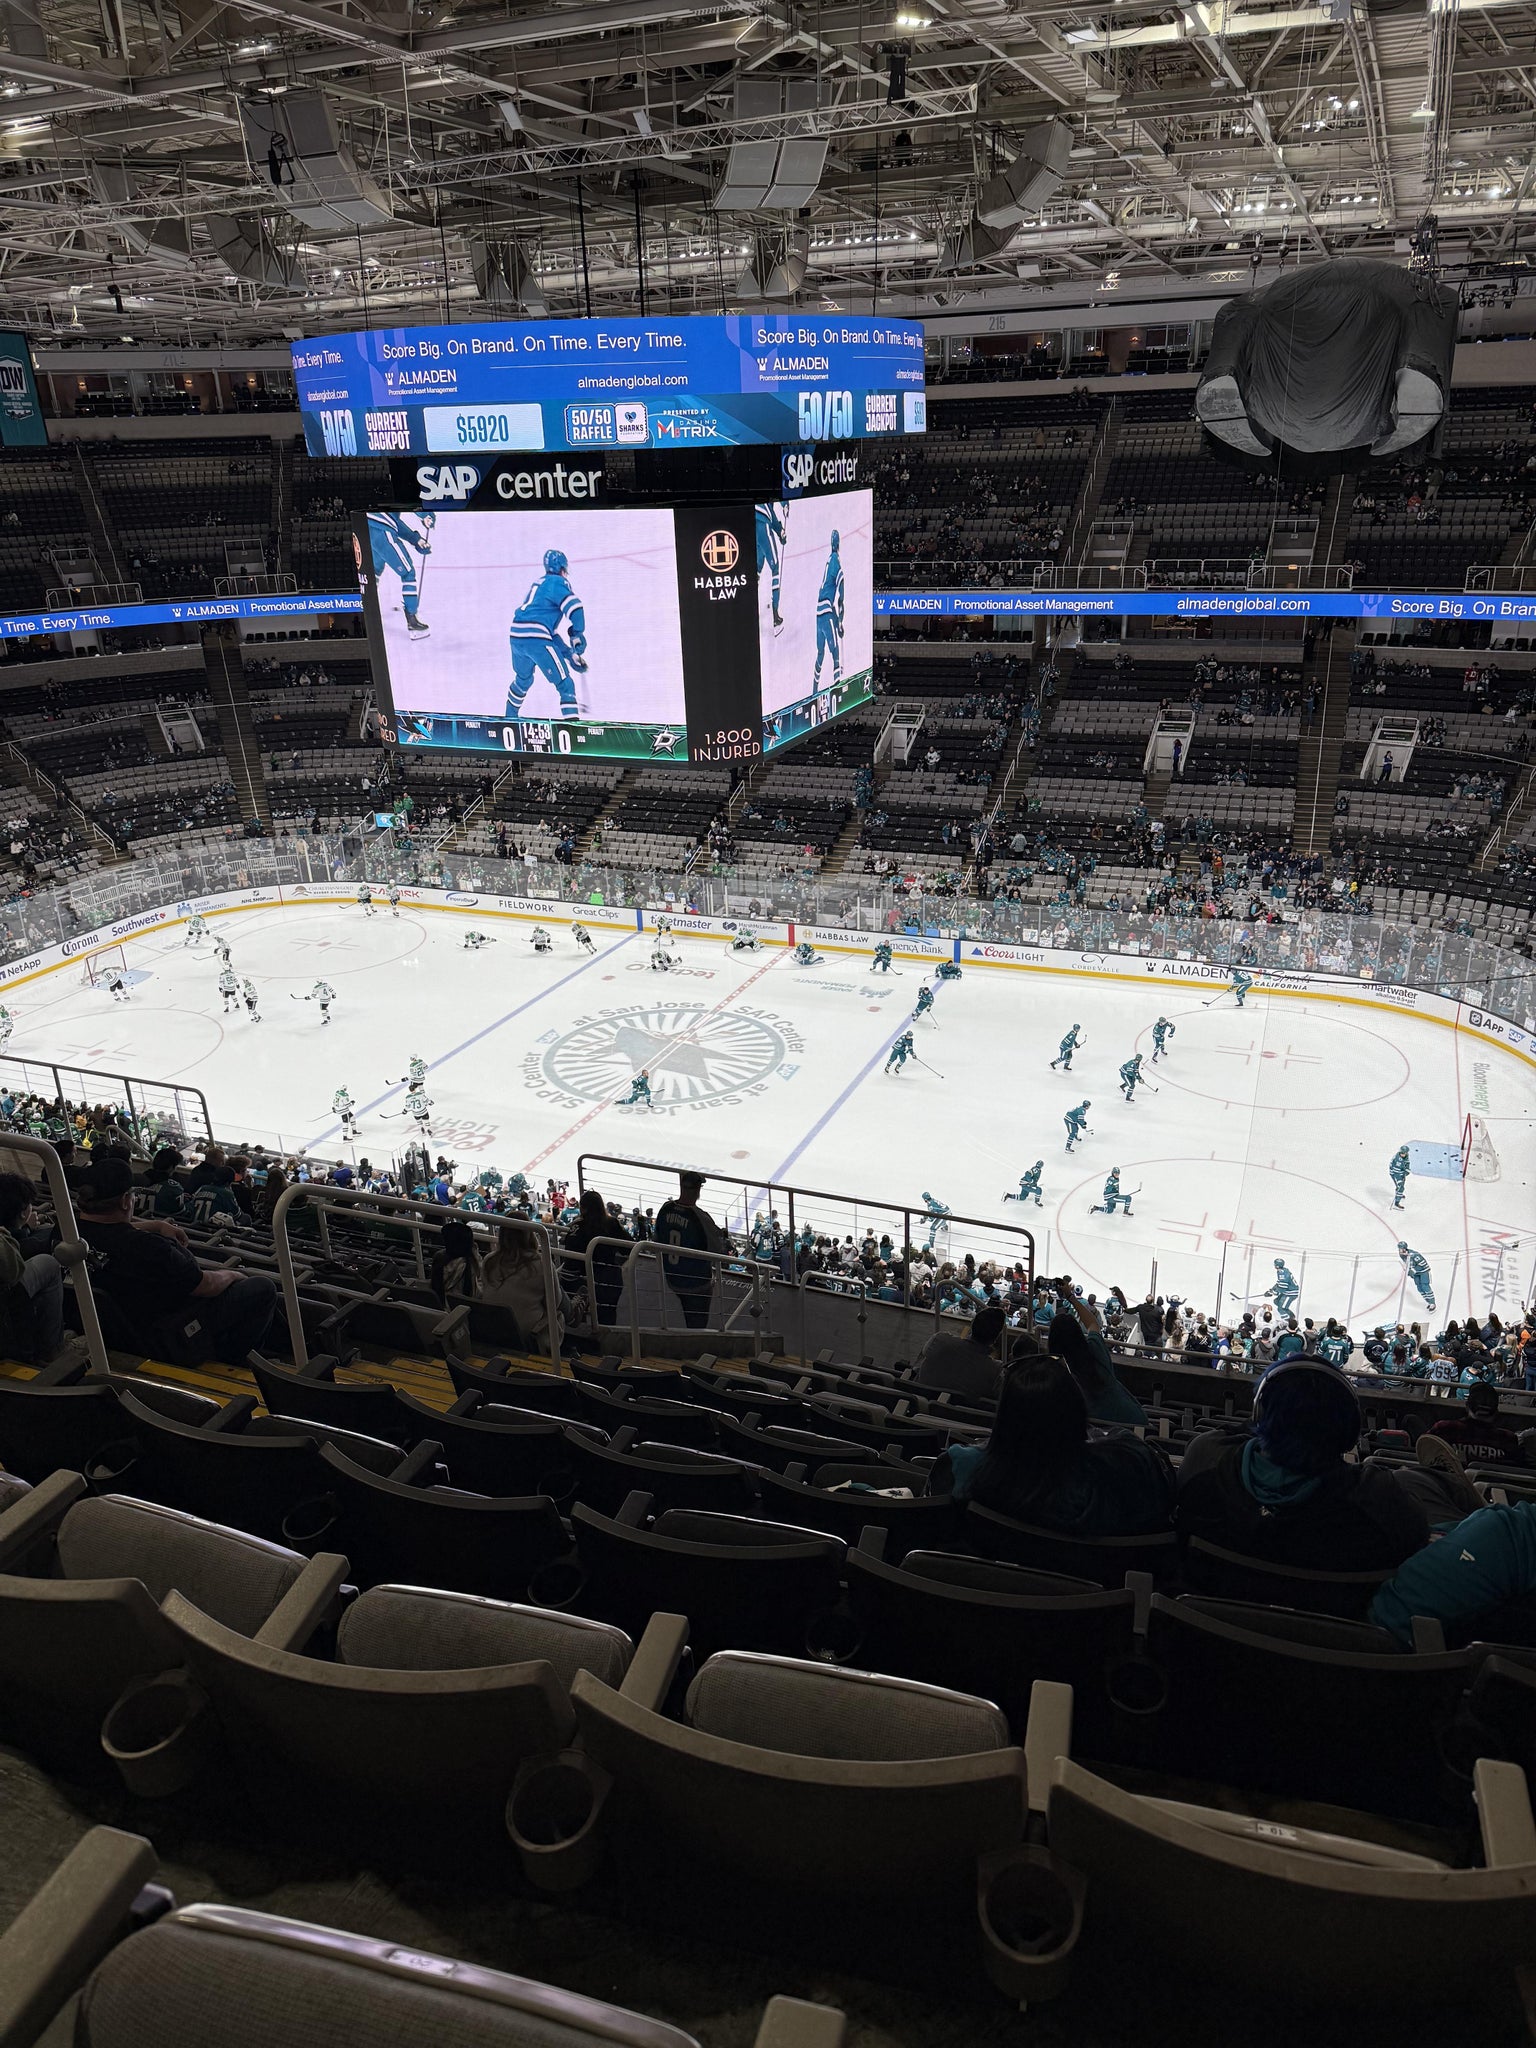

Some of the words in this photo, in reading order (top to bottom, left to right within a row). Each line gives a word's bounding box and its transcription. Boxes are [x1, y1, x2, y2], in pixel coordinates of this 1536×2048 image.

[988, 316, 1005, 331] 215
[383, 343, 416, 359] Score
[419, 341, 444, 359] Big.
[447, 339, 468, 356] On
[471, 337, 519, 355] Brand.
[523, 336, 546, 352] On
[549, 334, 592, 351] Time.
[597, 332, 641, 353] Every
[645, 331, 688, 348] Time.
[757, 328, 795, 345] Score
[798, 329, 820, 347] Big.
[823, 329, 839, 344] On
[841, 328, 871, 344] Brand.
[873, 329, 885, 345] On
[886, 330, 903, 346] Time.
[306, 352, 322, 368] Every
[322, 350, 344, 365] Time.
[773, 356, 829, 371] ALMADEN
[398, 368, 458, 386] ALMADEN
[578, 373, 688, 391] almadenglobal.com
[759, 374, 788, 382] Promotional
[787, 373, 800, 381] Asset
[800, 373, 829, 382] Management
[413, 386, 426, 395] Asset
[426, 386, 458, 396] Management
[866, 394, 897, 413] CURRENT
[364, 411, 408, 432] CURRENT
[572, 408, 611, 426] 50/50
[798, 391, 853, 441] 50/50
[866, 412, 897, 432] JACKPOT
[320, 409, 358, 457] 50/50
[456, 413, 510, 446] $5920
[573, 425, 613, 440] RAFFLE
[618, 424, 645, 433] SHARKS
[367, 430, 411, 451] JACKPOT
[785, 453, 815, 489] SAP
[820, 450, 858, 485] center
[416, 464, 479, 500] SAP
[496, 462, 602, 499] center
[694, 574, 747, 589] HABBAS
[709, 588, 737, 600] LAW
[186, 603, 240, 618] ALMADEN
[250, 600, 307, 614] Promotional
[307, 599, 334, 611] Asset
[889, 599, 942, 611] ALMADEN
[953, 598, 1014, 611] Promotional
[1015, 598, 1045, 611] Asset
[1045, 599, 1114, 613] Management
[1176, 596, 1311, 612] almadenglobal.com
[1391, 598, 1434, 615] Score
[1438, 600, 1467, 617] Big.
[1472, 600, 1495, 616] On
[4, 619, 40, 635] Time.
[42, 616, 78, 633] Every
[79, 613, 115, 627] Time.
[502, 726, 516, 751] 0
[522, 721, 551, 740] 14:53
[704, 729, 752, 745] 1.800
[558, 729, 572, 754] 0
[693, 741, 761, 762] INJURED
[498, 899, 555, 914] FIELDWORK
[572, 906, 598, 917] Great
[598, 908, 619, 919] Clips
[111, 911, 161, 937] Southwest
[61, 934, 100, 957] Corona
[815, 931, 849, 942] HABBAS
[850, 933, 870, 943] LAW
[920, 945, 943, 954] Bank
[983, 945, 1015, 960] Coors
[1016, 952, 1046, 963] LIGHT
[7, 958, 41, 977] NetApp
[1161, 963, 1230, 980] ALMADEN
[1254, 980, 1308, 991] CALIFORNIA
[1361, 983, 1419, 1000] smartwater
[599, 1004, 644, 1018] San
[647, 1000, 706, 1011] Jose
[734, 1004, 778, 1023] SAP
[774, 1019, 808, 1054] Center
[1482, 1018, 1504, 1033] App
[517, 1051, 542, 1090] Center
[410, 1099, 422, 1110] 73
[535, 1089, 586, 1110] SAP
[691, 1094, 744, 1112] San
[618, 1105, 677, 1117] Jose
[1328, 1349, 1342, 1361] 71
[1435, 1365, 1450, 1380] 69
